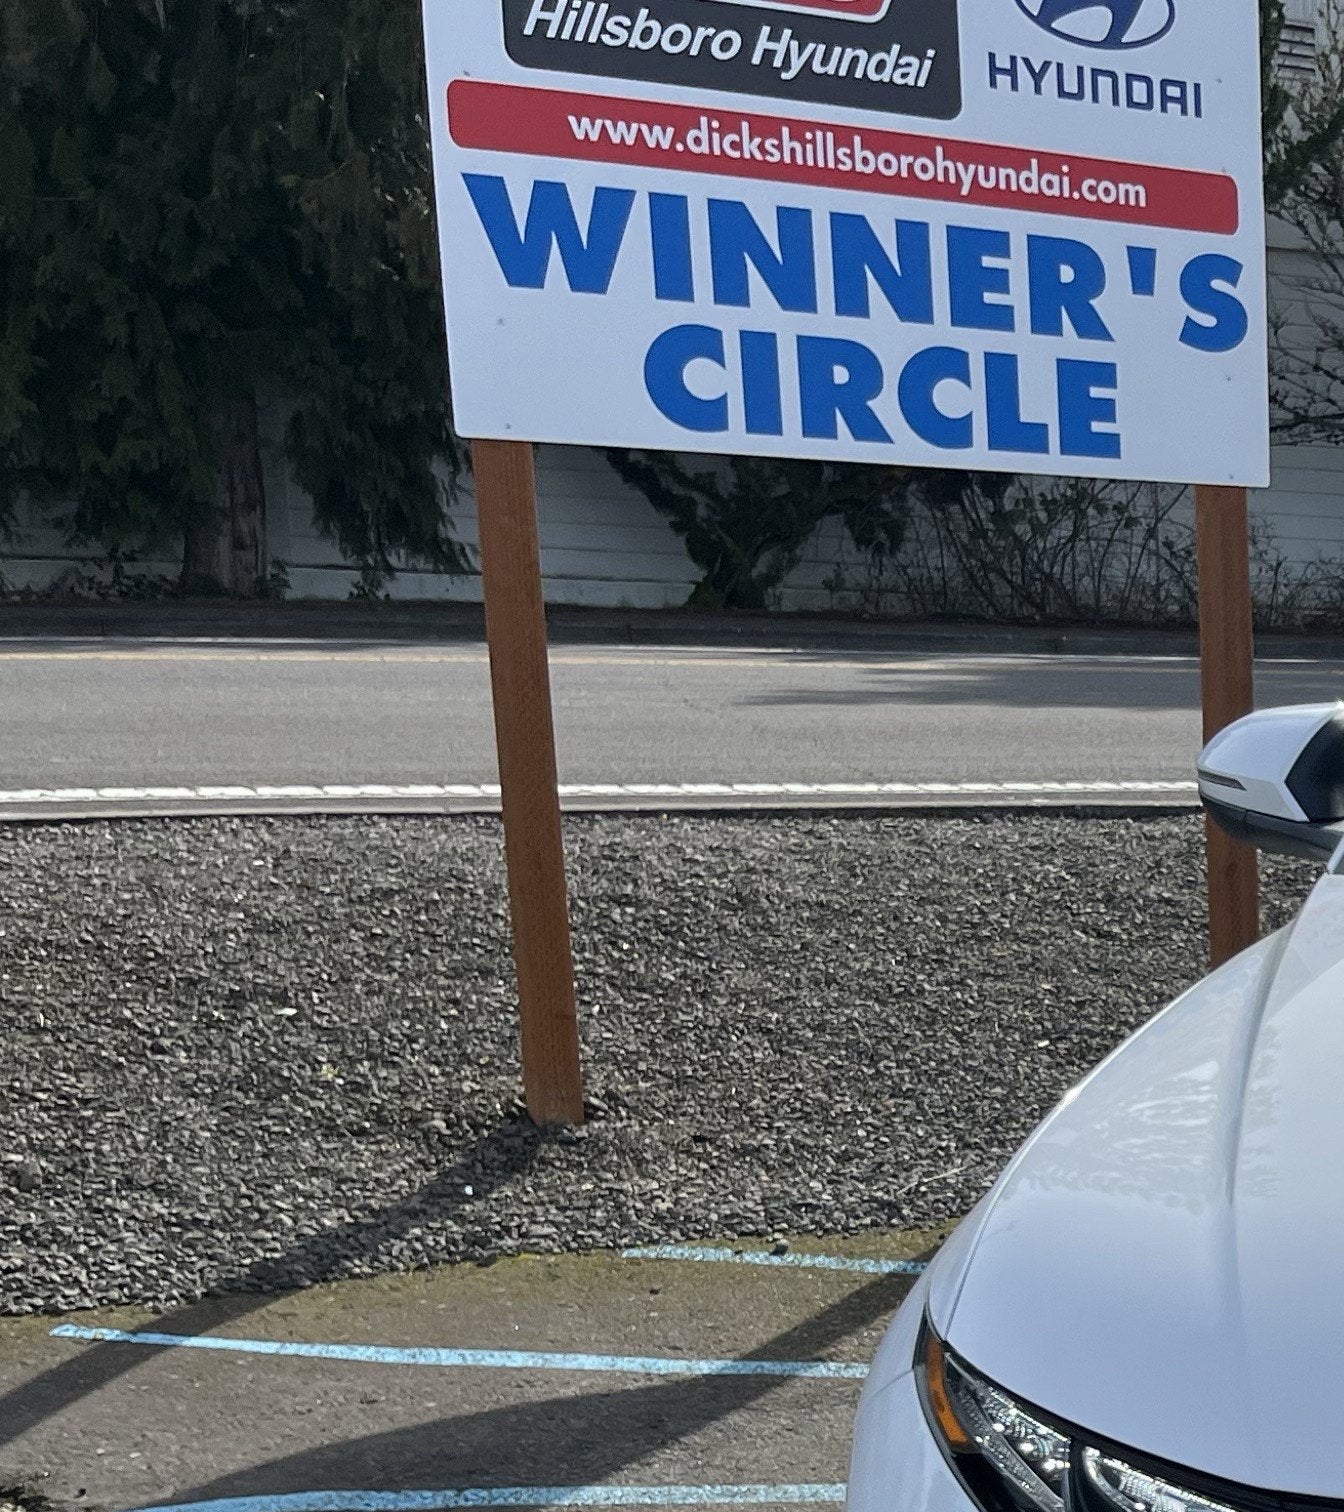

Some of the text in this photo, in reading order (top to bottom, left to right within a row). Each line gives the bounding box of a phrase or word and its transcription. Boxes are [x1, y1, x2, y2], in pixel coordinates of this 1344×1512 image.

[522, 0, 937, 88] Hillsboro Hyundai
[987, 51, 1202, 118] HYUNDAI
[567, 115, 1147, 208] www.dickshillsborohyundai.com
[461, 172, 1249, 352] WINNER'S
[643, 323, 1122, 459] CIRCLE
